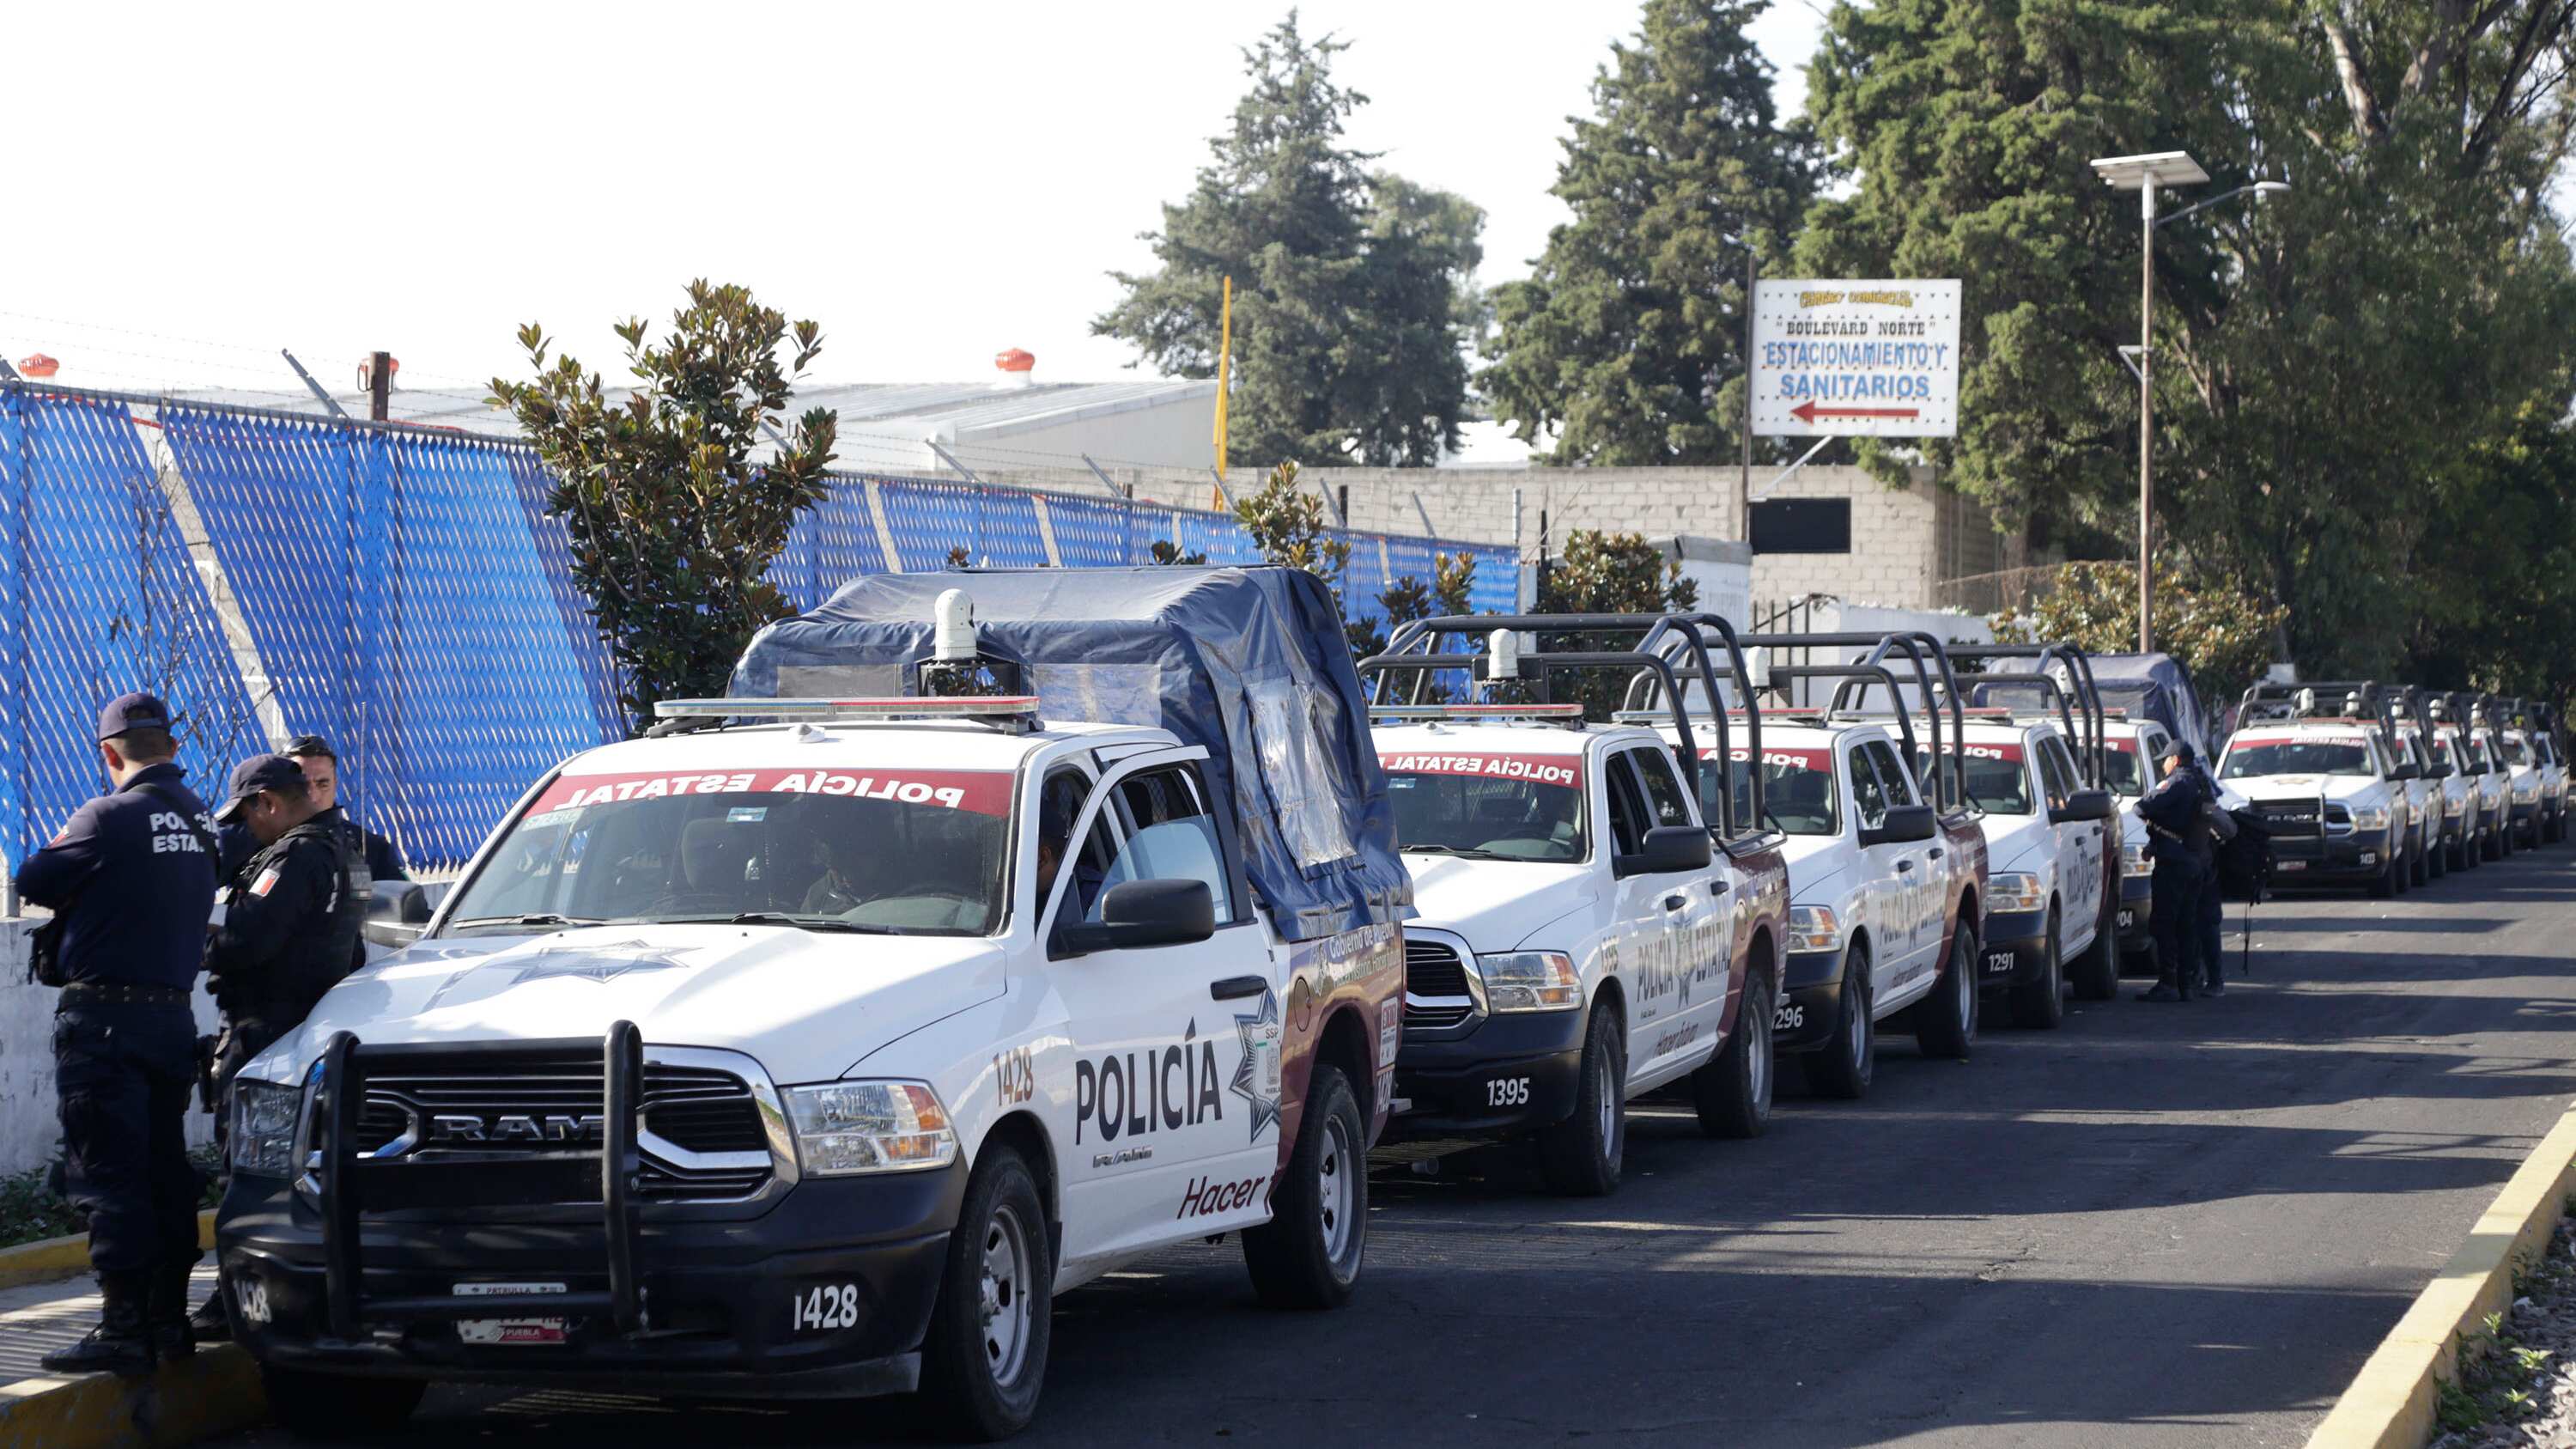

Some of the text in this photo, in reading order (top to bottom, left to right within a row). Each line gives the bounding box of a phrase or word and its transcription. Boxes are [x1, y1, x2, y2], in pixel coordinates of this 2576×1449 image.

[1787, 321, 1925, 336] BOULEVARD NORTE
[1766, 342, 1946, 366] ESTACIONAMIENTO Y
[1780, 374, 1929, 397] SANITARIOS
[1328, 931, 1364, 959] Gobierno
[1364, 928, 1374, 947] de
[1637, 930, 1674, 1003] POLICÍA
[1989, 952, 2014, 971] 1291
[993, 1045, 1034, 1106] 1428
[1075, 1016, 1222, 1145] POLICÍA
[1487, 1076, 1529, 1105] 1395
[428, 1115, 605, 1142] RAM
[1176, 1176, 1266, 1220] Hacer
[233, 1279, 272, 1324] 1428
[793, 1283, 858, 1330] 1428
